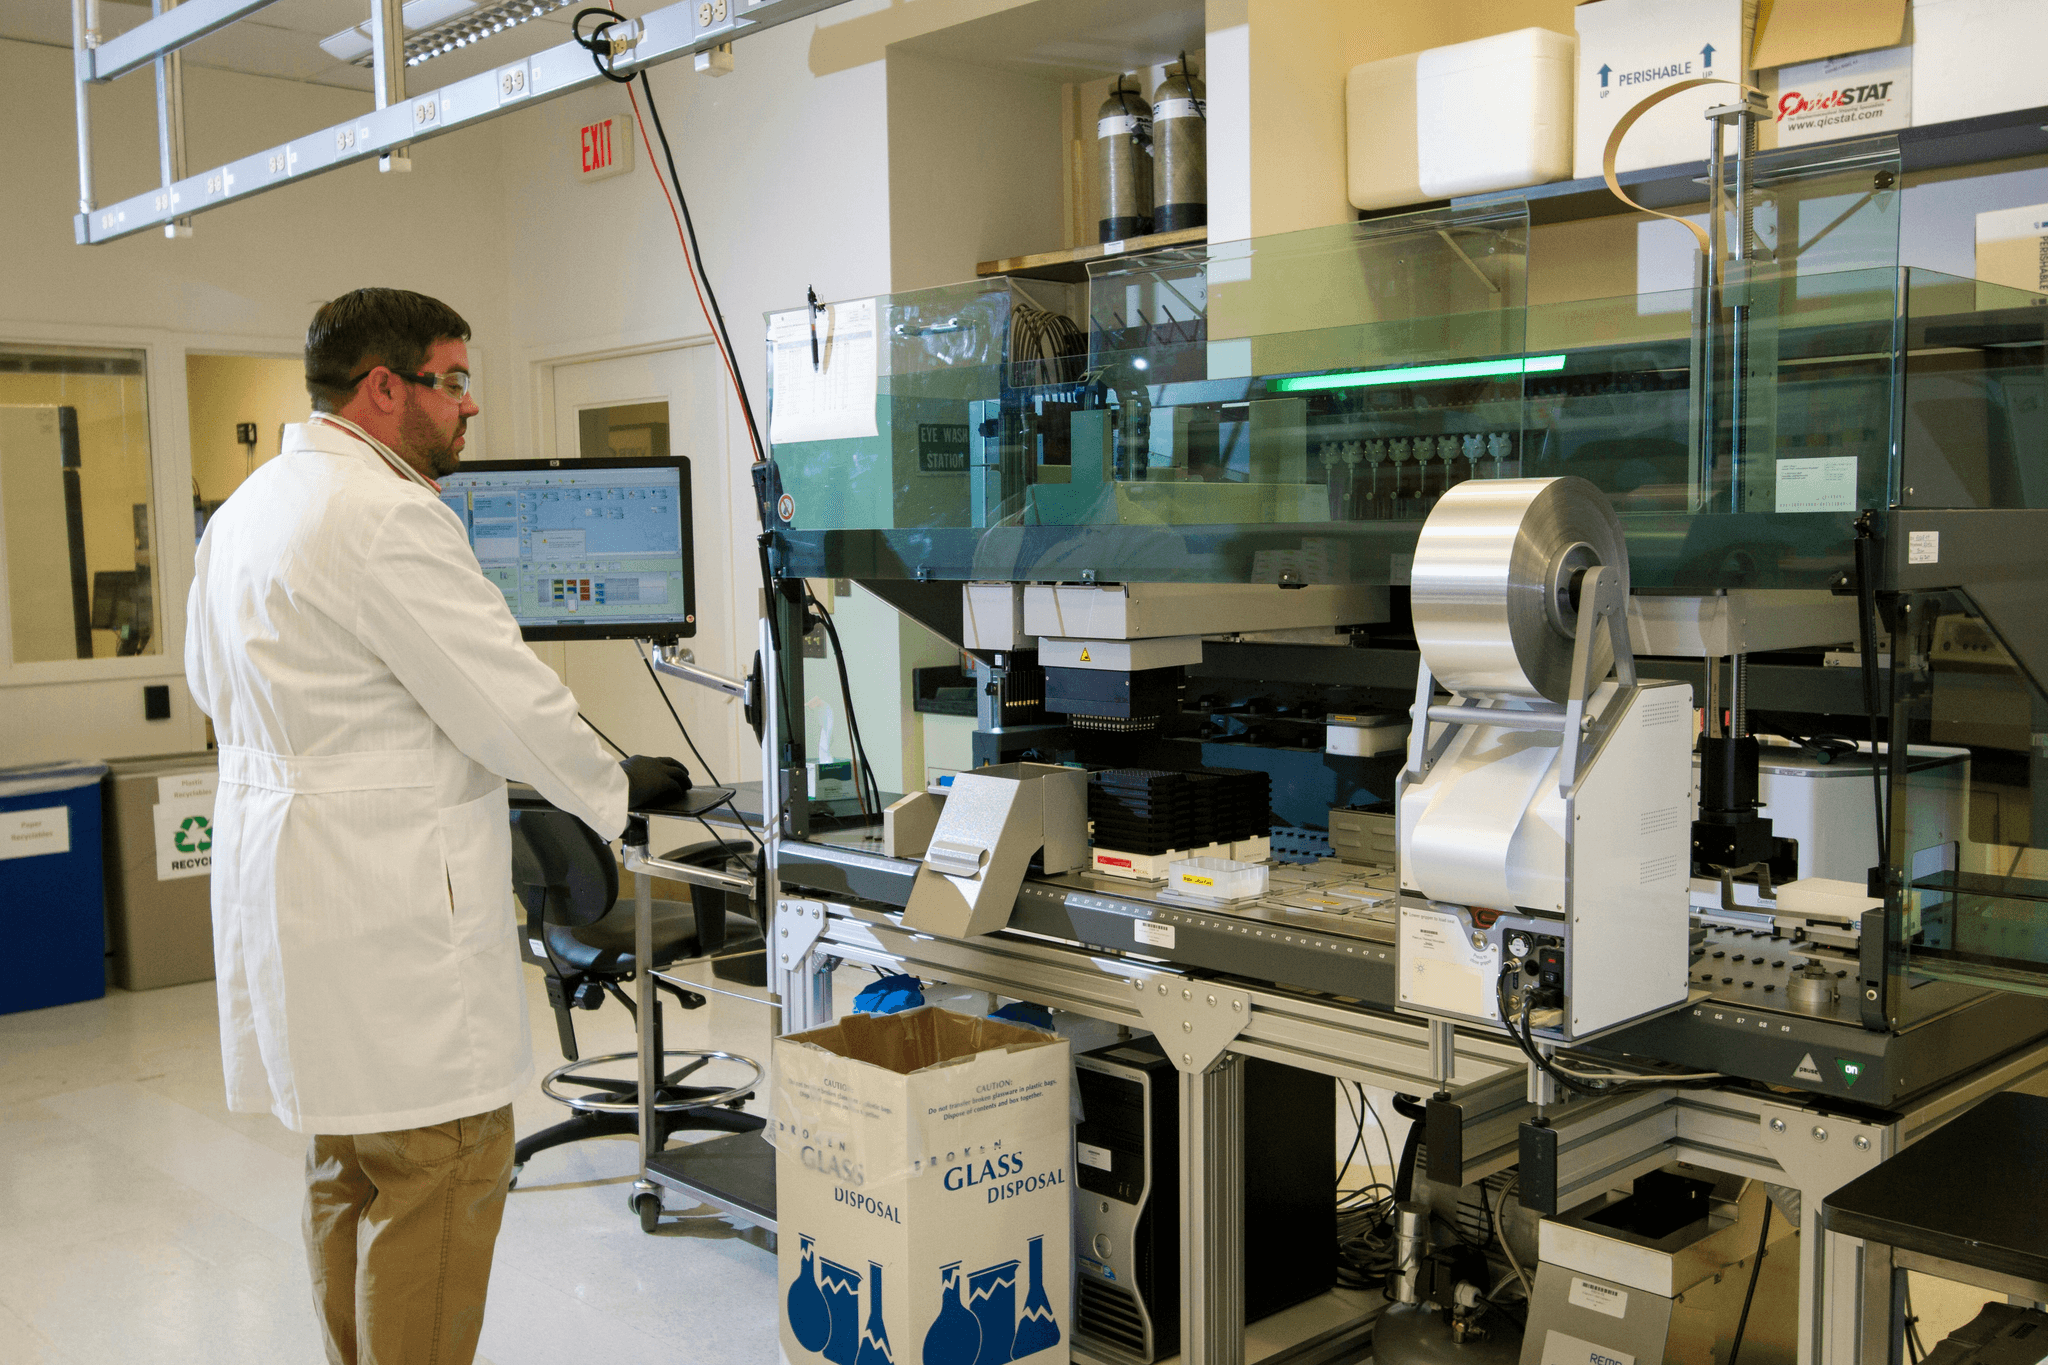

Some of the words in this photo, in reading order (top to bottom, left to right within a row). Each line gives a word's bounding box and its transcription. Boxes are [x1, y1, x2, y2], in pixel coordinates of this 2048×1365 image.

[1619, 61, 1692, 87] PERISHABLE
[1599, 90, 1610, 99] UP
[1788, 109, 1883, 132] www.qicstat.com
[581, 119, 612, 173] EXIT
[920, 427, 938, 442] EYE
[943, 427, 969, 443] WASH
[927, 453, 964, 468] STATION
[181, 779, 203, 787] Plastic
[174, 789, 212, 799] Recyclables
[1799, 1066, 1819, 1076] pause
[1845, 1064, 1858, 1075] on
[823, 1078, 854, 1093] CAUTIO
[949, 1100, 970, 1110] transfer
[972, 1095, 991, 1104] broken
[992, 1089, 1018, 1101] glassware
[1026, 1081, 1043, 1092] plastic
[1044, 1079, 1057, 1087] bags.
[976, 1079, 1013, 1094] CAUTION:
[944, 1111, 965, 1121] Dispose
[974, 1103, 997, 1113] contents
[998, 1099, 1008, 1107] and
[1020, 1092, 1043, 1102] together.
[801, 1145, 864, 1187] GLASS
[943, 1151, 1023, 1191] GLASS
[987, 1169, 1065, 1204] DISPOSAL
[834, 1187, 901, 1225] DISPOSAL
